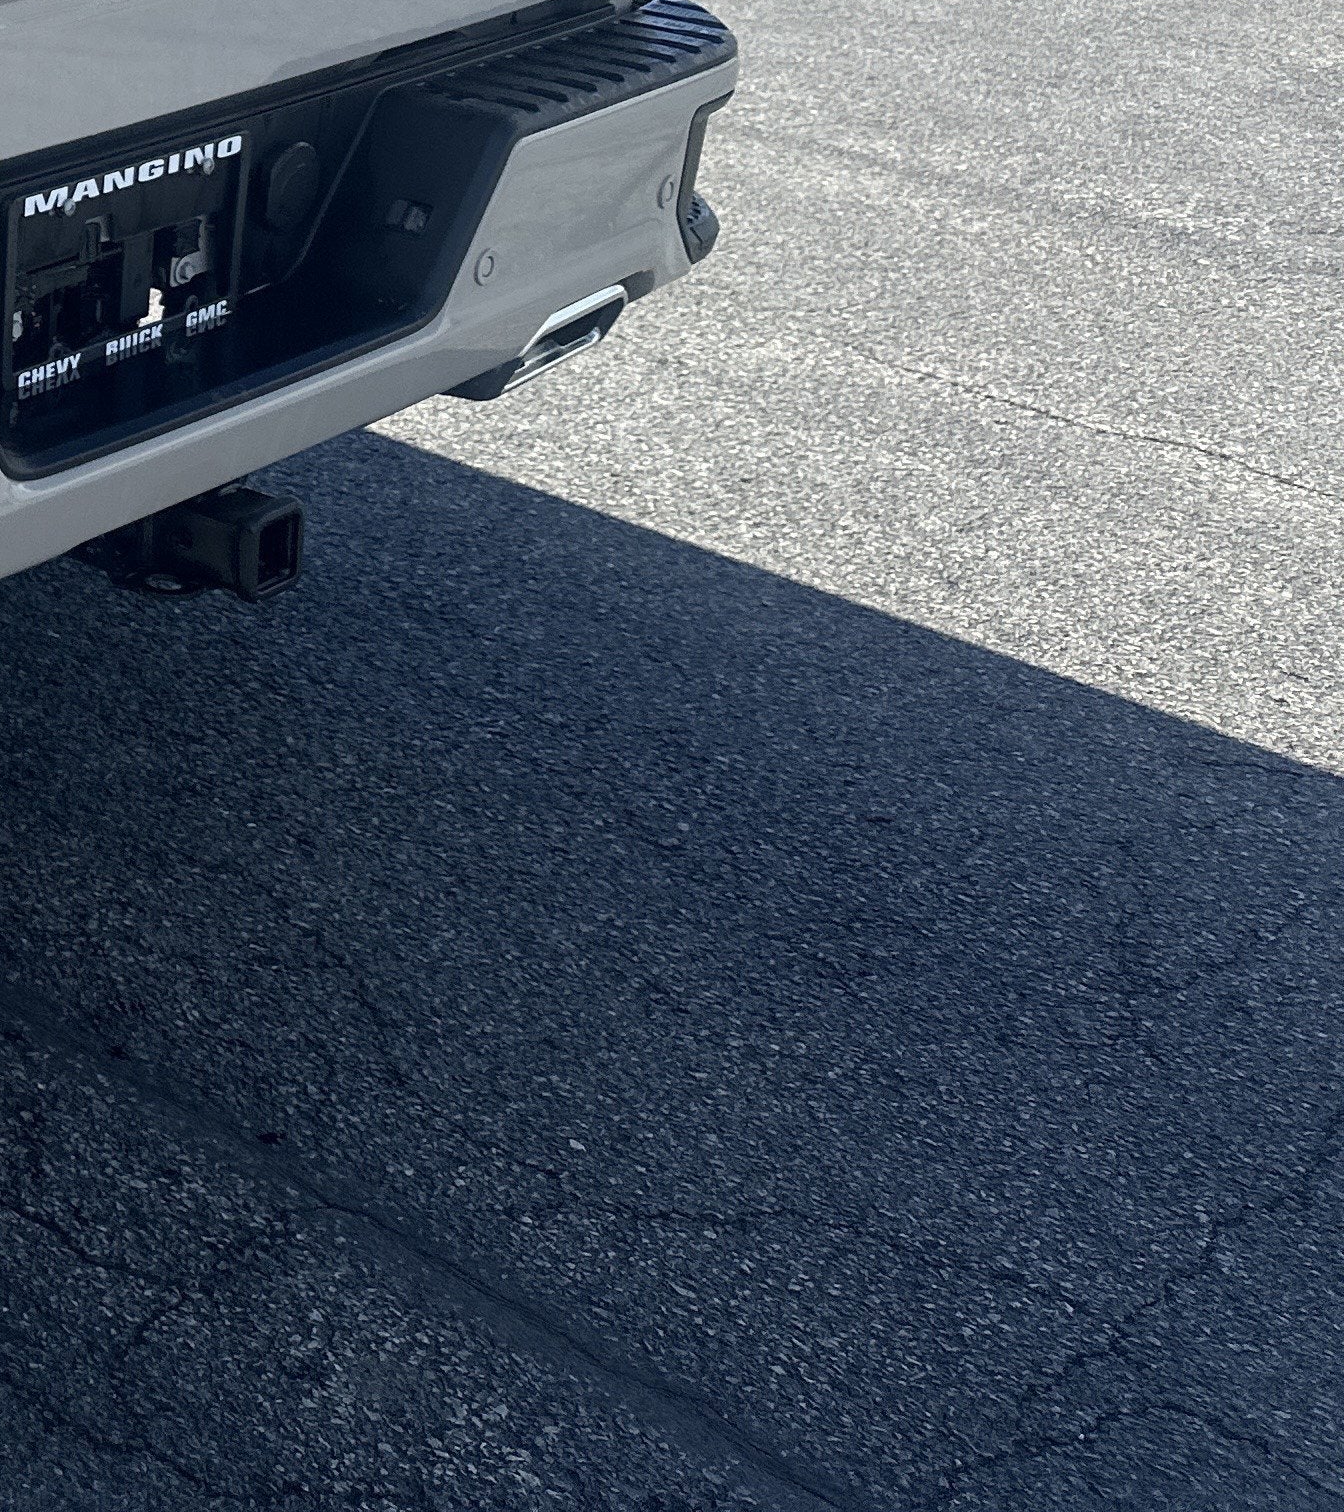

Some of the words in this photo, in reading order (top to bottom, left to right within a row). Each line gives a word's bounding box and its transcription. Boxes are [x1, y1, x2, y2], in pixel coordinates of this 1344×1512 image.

[23, 135, 243, 217] MANGINO
[18, 353, 82, 388] CHEVY
[106, 324, 163, 356] BUICK
[185, 299, 229, 328] GMC
